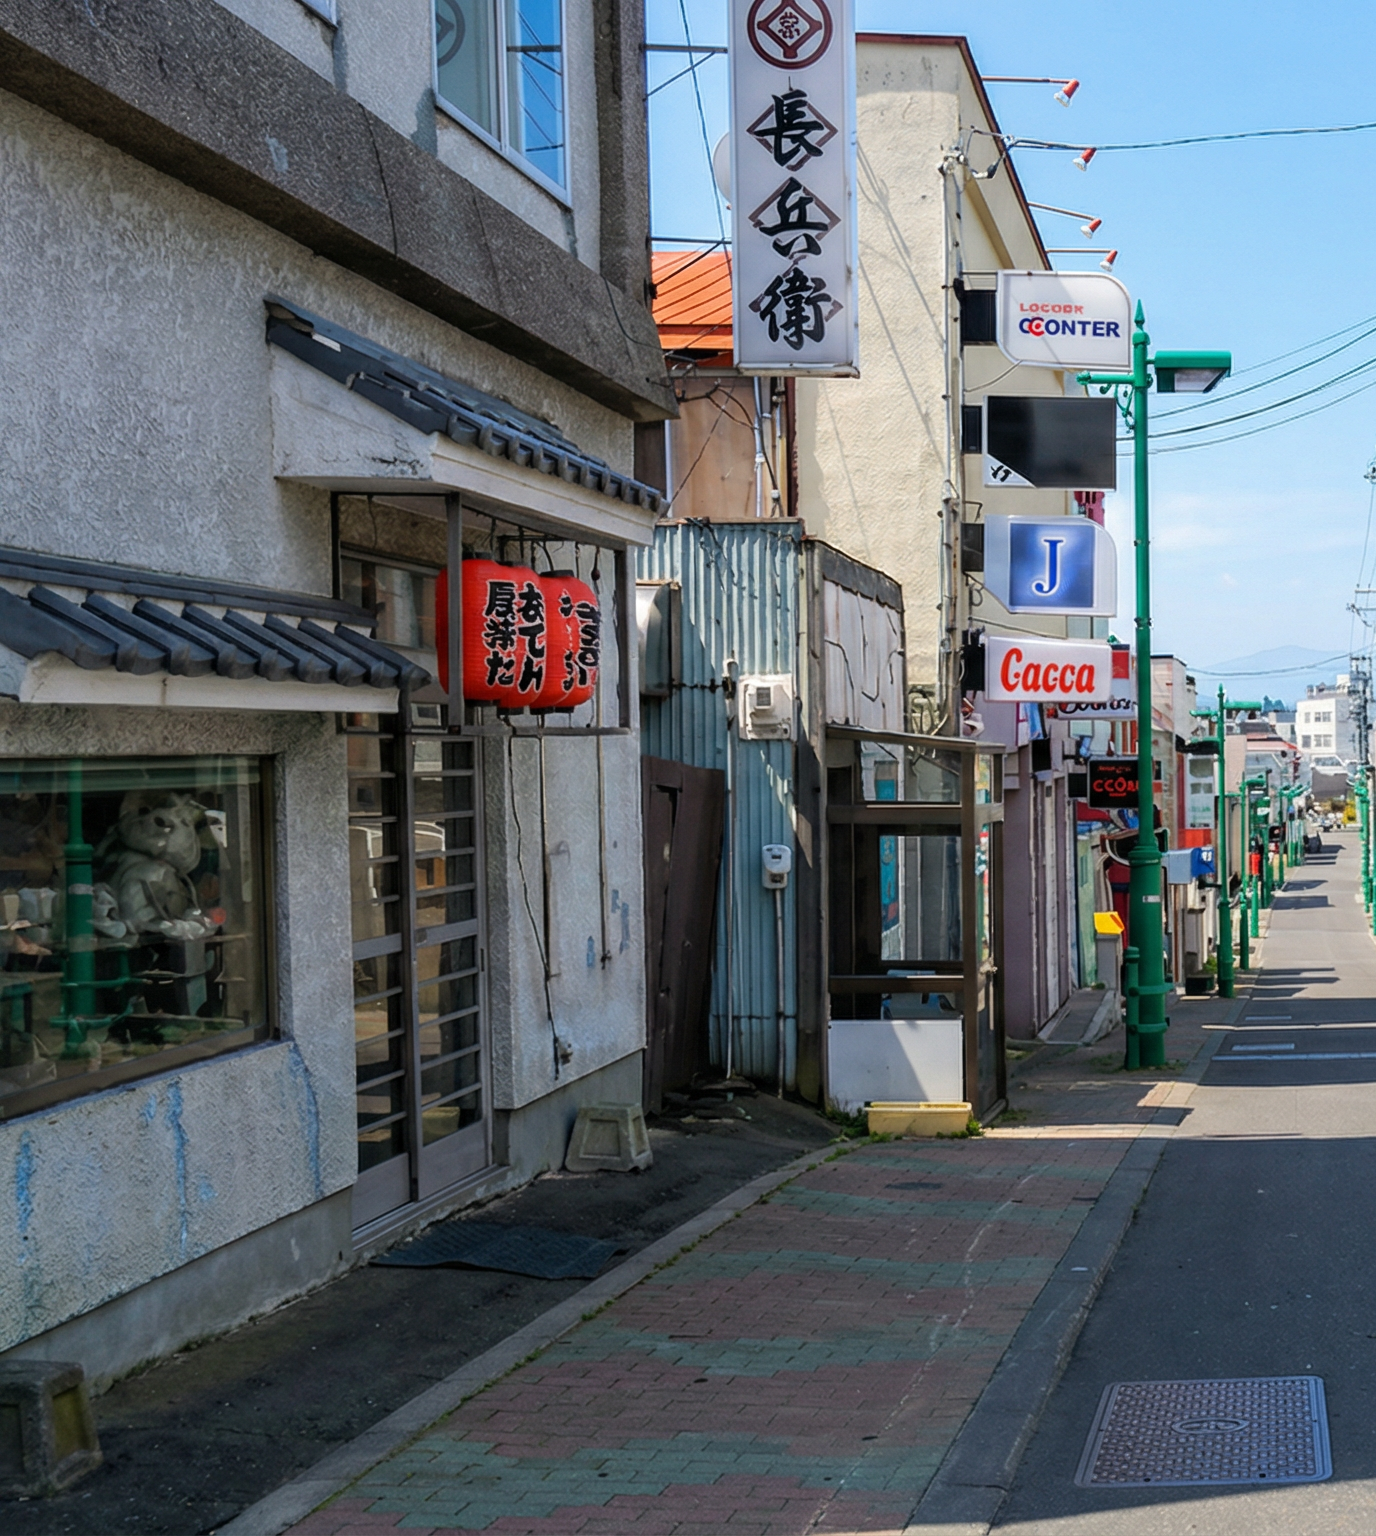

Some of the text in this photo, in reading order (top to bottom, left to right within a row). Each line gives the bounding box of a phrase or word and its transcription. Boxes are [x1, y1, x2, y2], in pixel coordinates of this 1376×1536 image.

[753, 88, 832, 350] 長兵衛
[1033, 538, 1064, 595] J
[1000, 648, 1096, 694] Cacca
